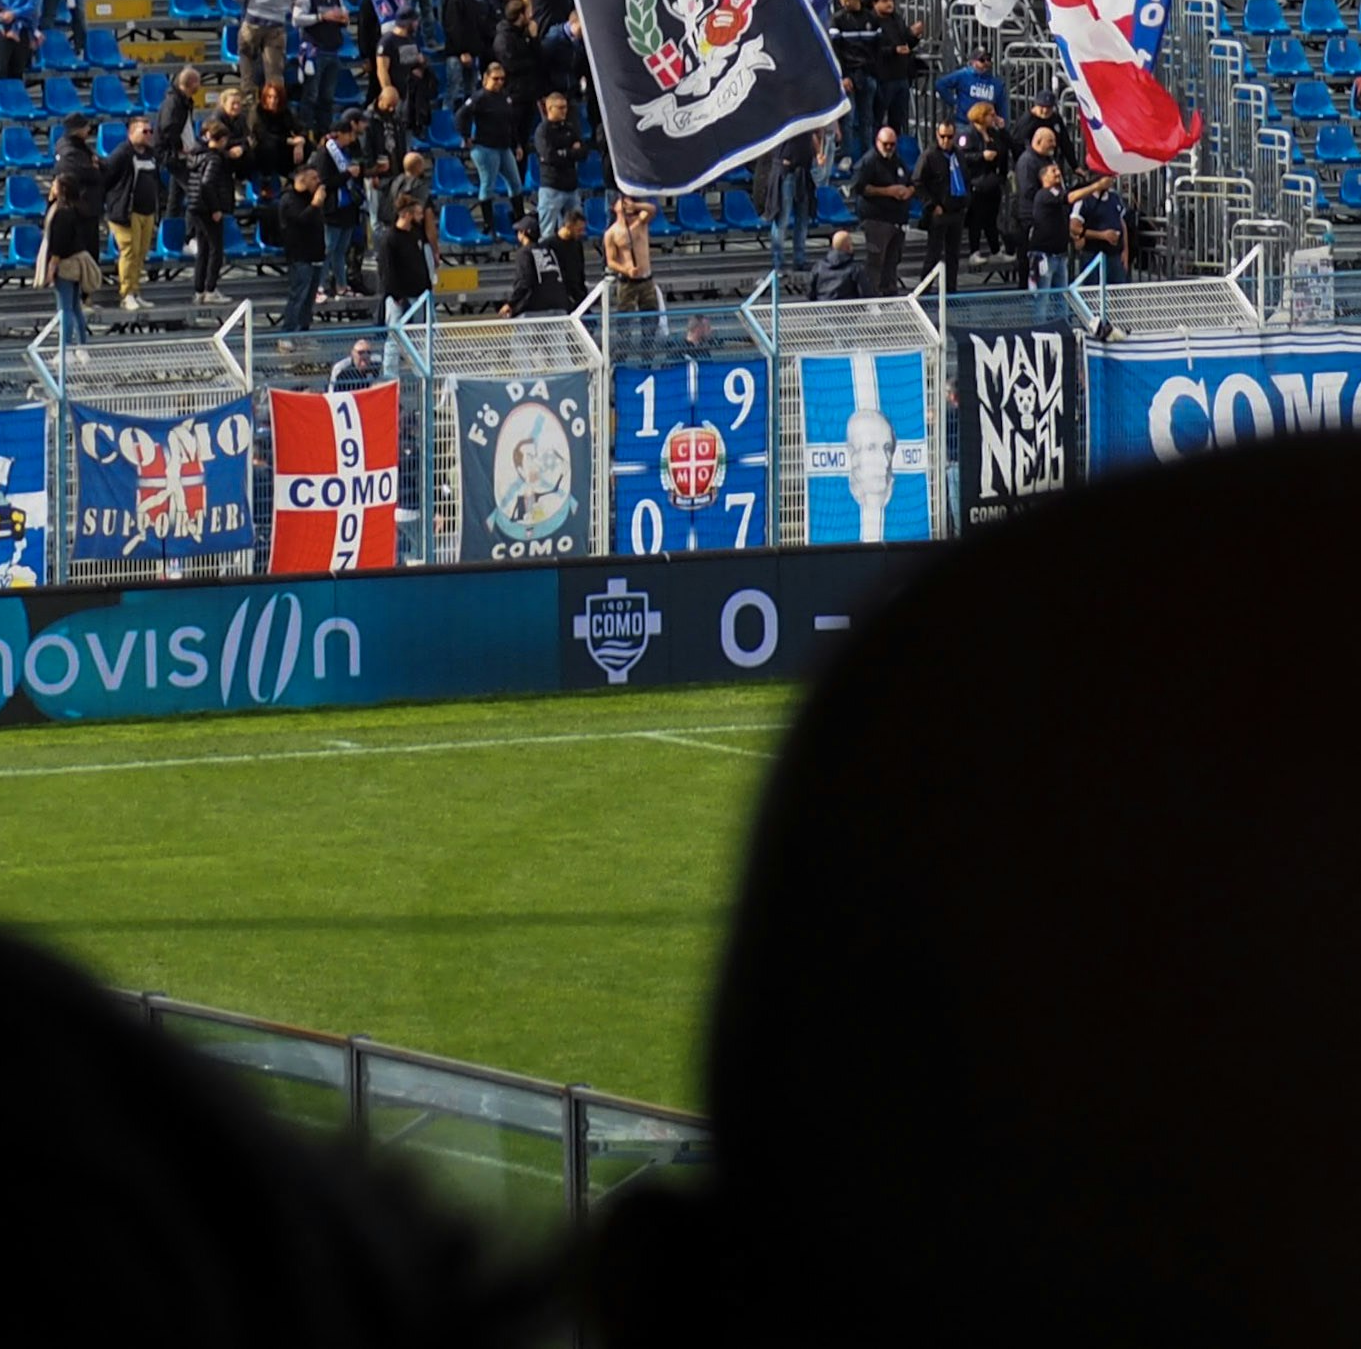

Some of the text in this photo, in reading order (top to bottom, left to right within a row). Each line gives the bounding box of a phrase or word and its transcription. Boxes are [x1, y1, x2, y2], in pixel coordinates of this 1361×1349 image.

[969, 331, 1064, 414] MAD
[506, 380, 550, 403] DA
[81, 413, 251, 466] COMO
[811, 451, 845, 468] COMO
[290, 471, 393, 509] COMO
[491, 535, 574, 560] COMO
[591, 612, 643, 639] COMO
[720, 588, 779, 669] 0
